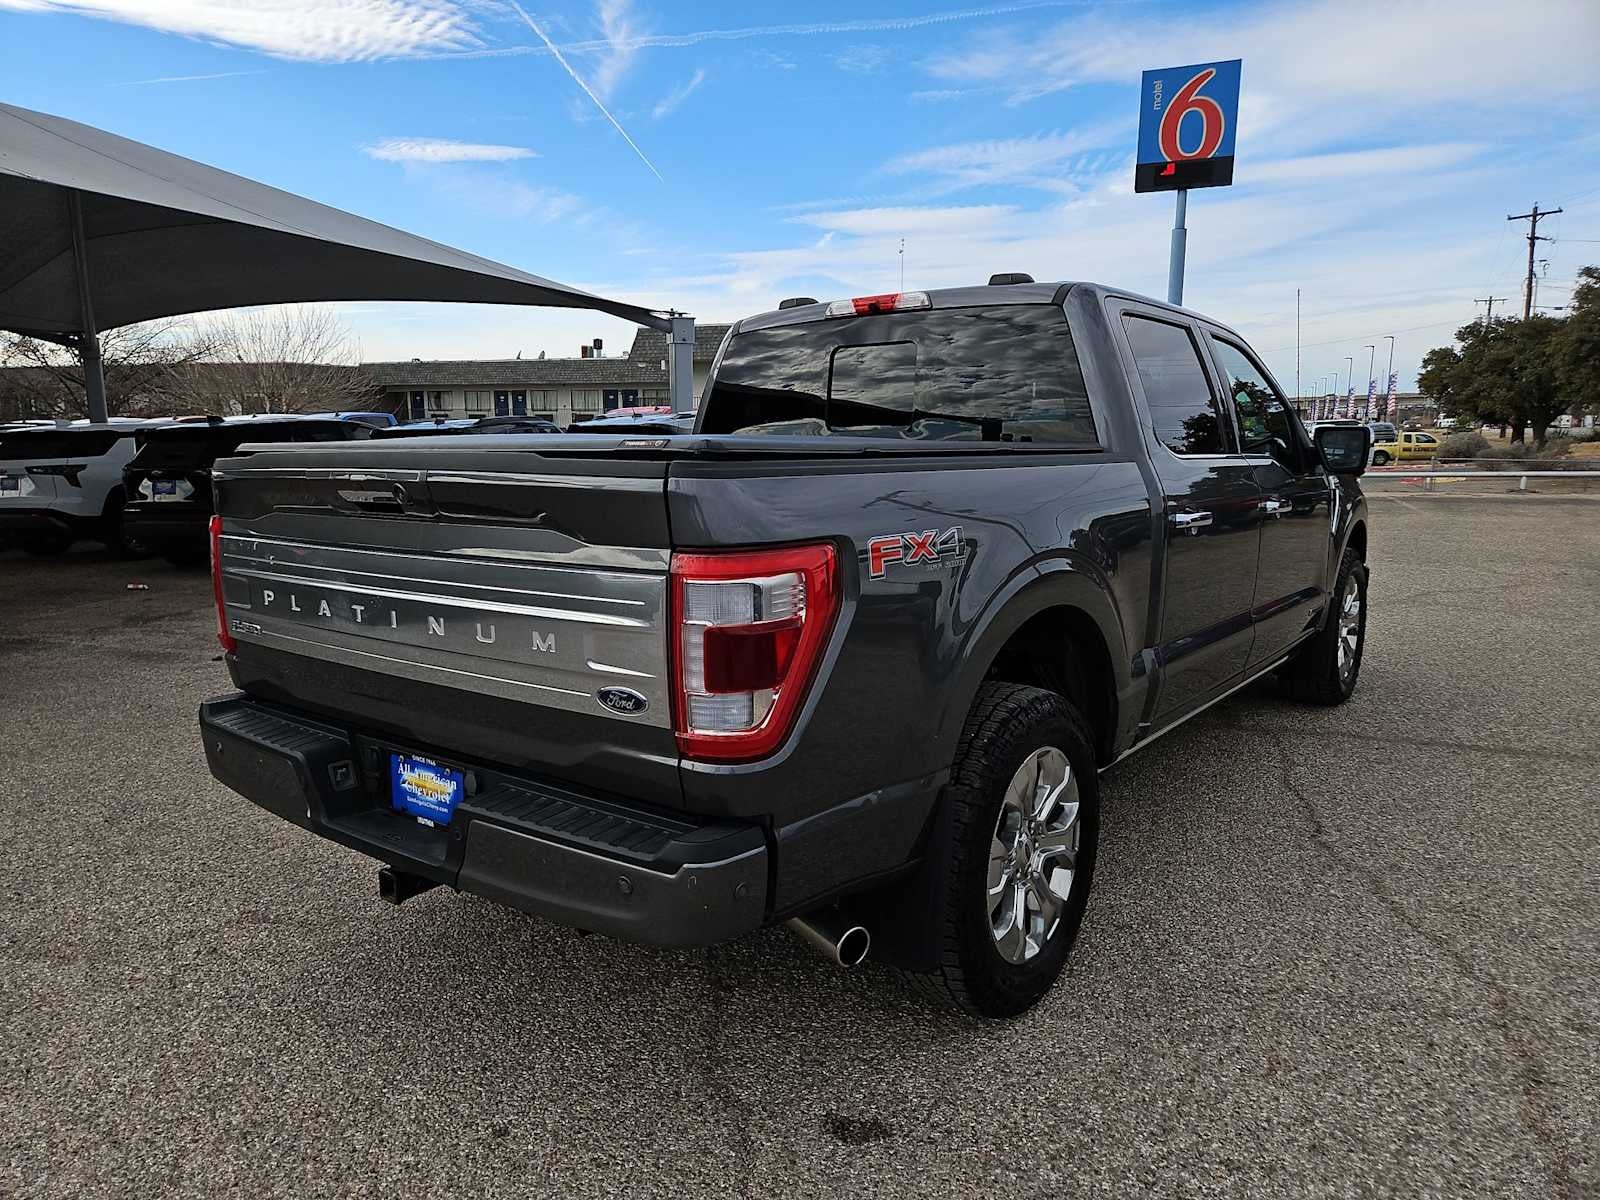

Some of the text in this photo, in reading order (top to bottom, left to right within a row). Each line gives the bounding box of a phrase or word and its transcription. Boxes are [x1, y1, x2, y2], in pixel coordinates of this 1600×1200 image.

[1153, 67, 1225, 162] motel 6
[867, 525, 967, 581] FX4
[263, 589, 558, 654] PLATINUM
[606, 690, 636, 710] Ford
[398, 763, 457, 790] All American
[406, 780, 450, 804] Chevrolet
